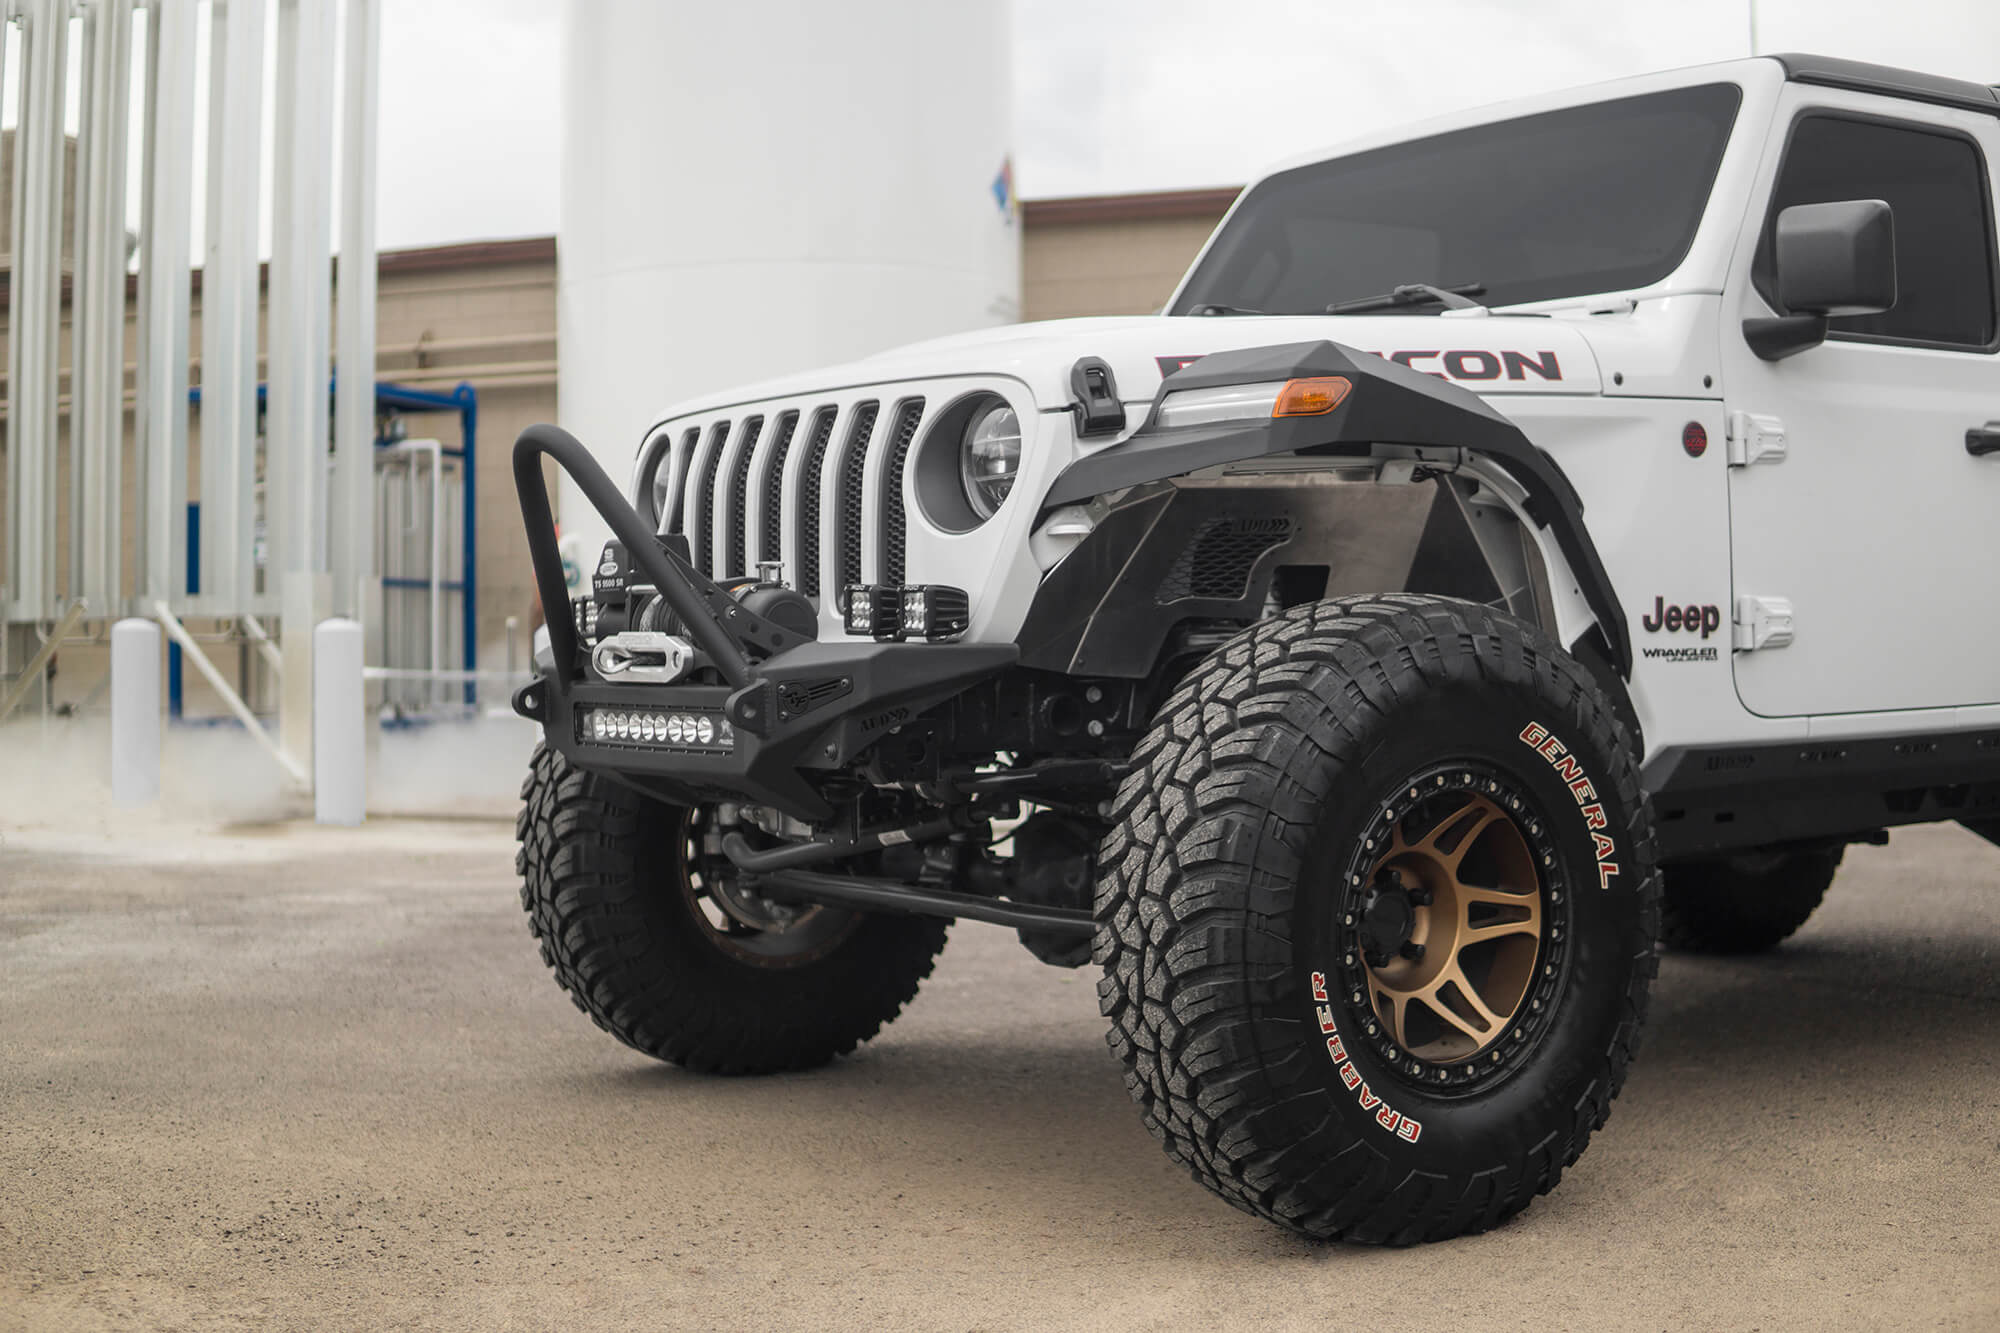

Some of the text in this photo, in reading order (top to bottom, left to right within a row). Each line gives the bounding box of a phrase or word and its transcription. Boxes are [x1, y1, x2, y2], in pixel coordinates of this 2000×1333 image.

[1642, 595, 1720, 640] Jeep
[1642, 648, 1718, 658] WRANGLER
[1519, 720, 1620, 890] GENERAL
[1311, 971, 1422, 1144] GRABBER
